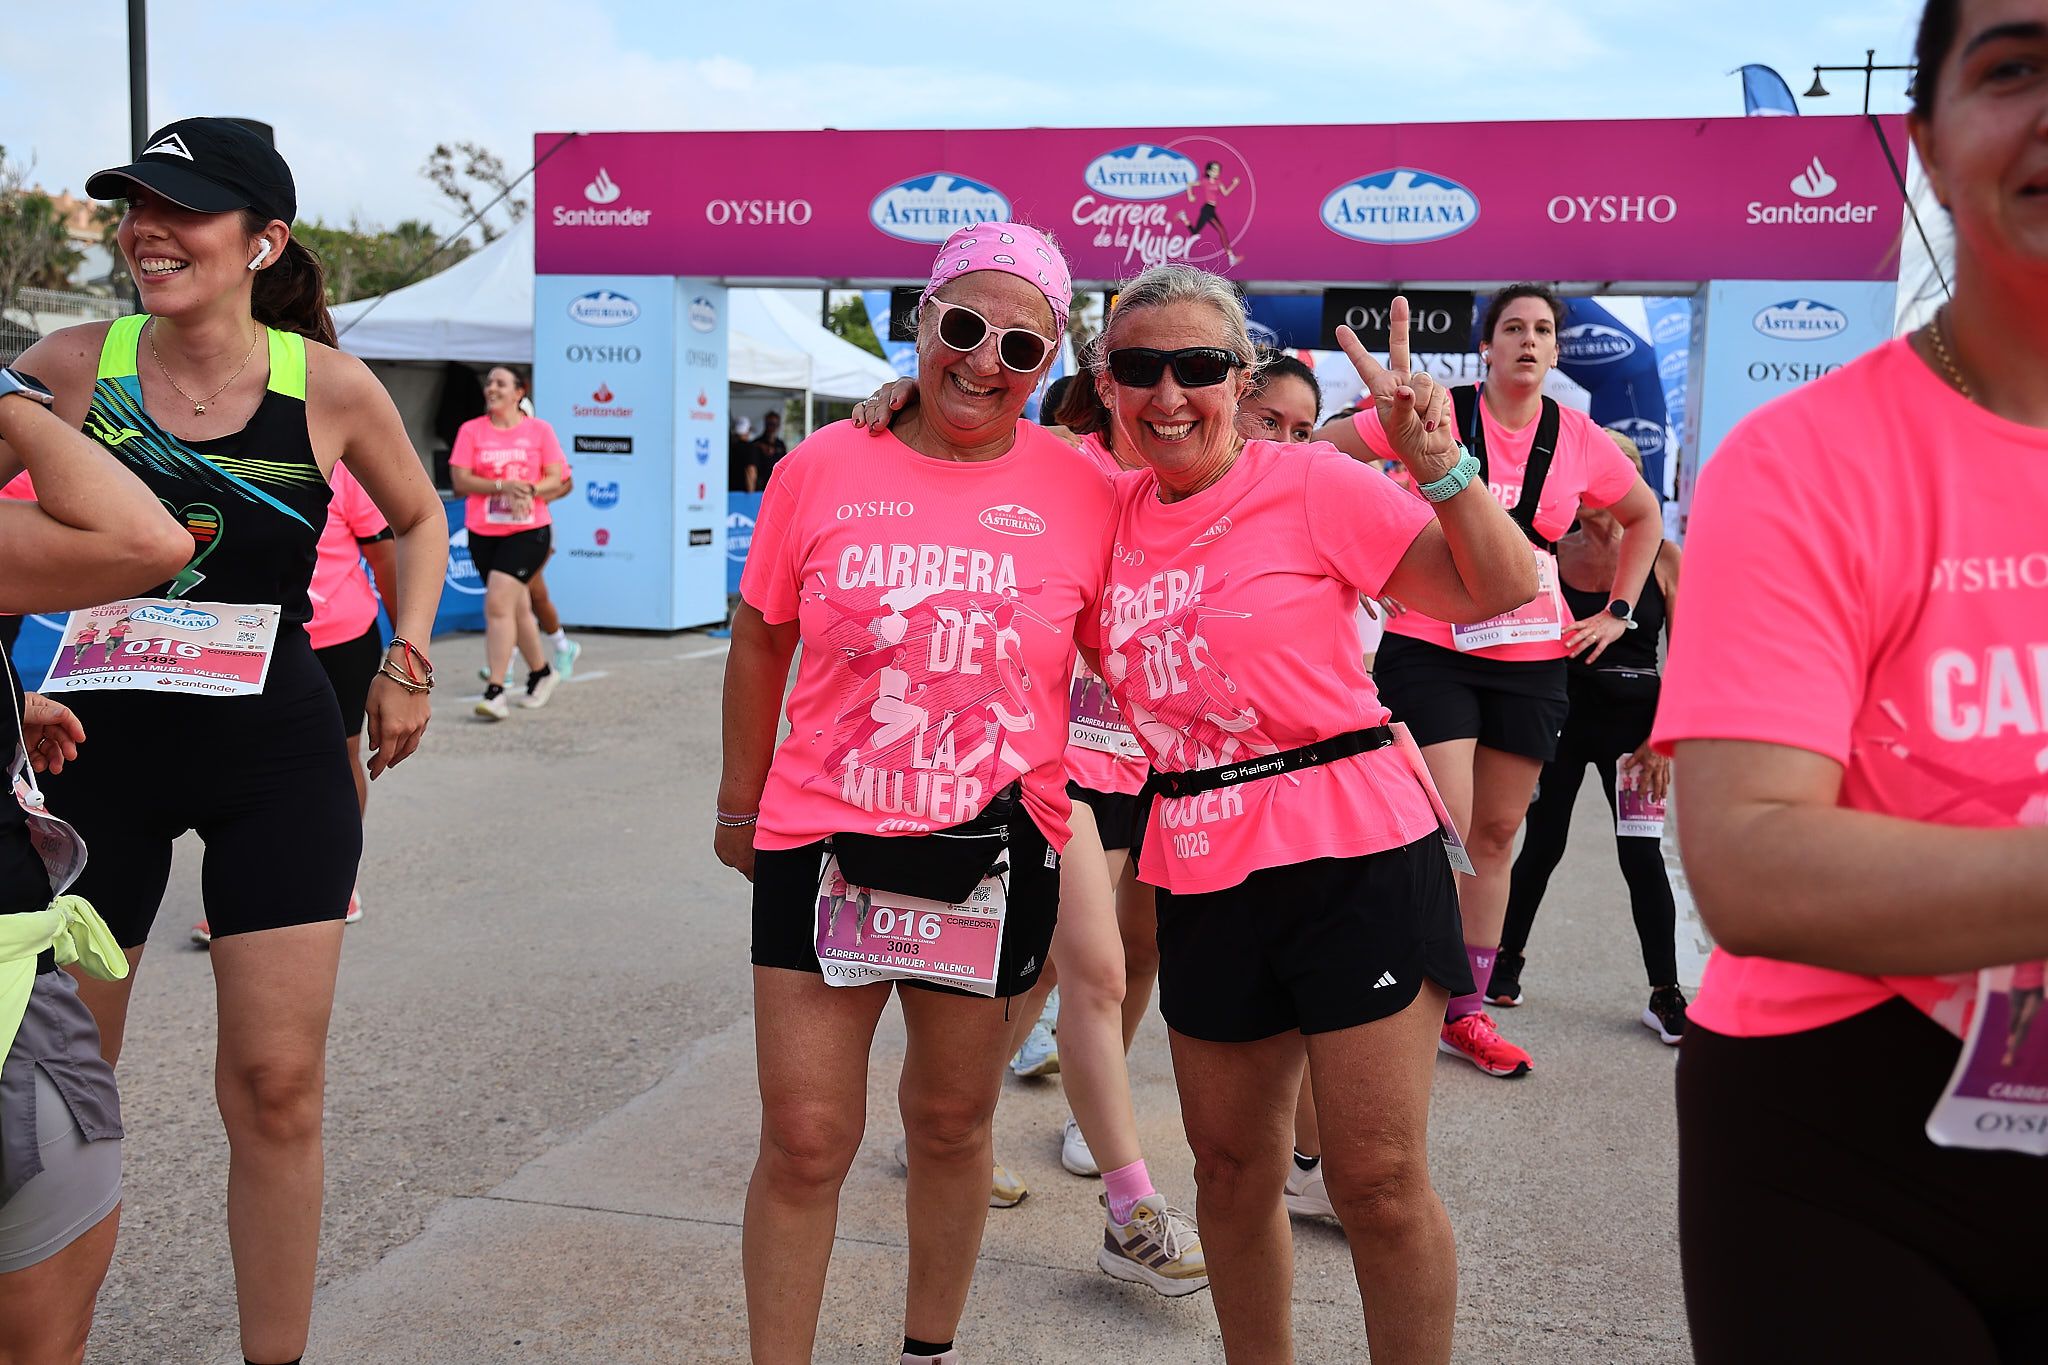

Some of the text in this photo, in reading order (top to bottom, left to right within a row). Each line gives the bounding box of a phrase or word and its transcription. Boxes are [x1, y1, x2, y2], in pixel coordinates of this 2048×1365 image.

[1094, 166, 1188, 186] ASTURIANA
[553, 206, 652, 227] Santander
[705, 199, 812, 226] OYSHO
[881, 200, 999, 225] ASTURIANA
[1072, 195, 1167, 228] Carrera
[1333, 198, 1466, 224] ASTURIANA
[1547, 195, 1677, 224] OYSHO
[1746, 202, 1878, 225] Santander
[1094, 223, 1201, 266] de la Mujer
[1345, 305, 1452, 335] OYHO
[1760, 315, 1841, 331] ASTURIANA
[566, 345, 642, 364] OYSHO
[572, 404, 634, 418] Santander
[576, 437, 631, 453] Neutrogena
[836, 501, 914, 520] OYSHO
[984, 512, 1041, 532] ASTURIANA
[1113, 542, 1145, 567] SHO
[836, 543, 1019, 597] CARRERA
[91, 607, 129, 618] SUMA
[136, 608, 212, 628] ASTURIANA
[926, 607, 995, 676] DE
[1465, 629, 1551, 645] OYSHO Santander
[124, 639, 202, 658] 016
[207, 649, 264, 658] CORREDORA
[140, 655, 178, 665] 3495
[1138, 625, 1190, 700] DE
[69, 665, 115, 677] CARRERA
[117, 664, 132, 672] DE
[149, 664, 184, 674] MUJER
[193, 668, 241, 681] VALENCIA
[66, 675, 238, 694] OYSHO Santander
[1076, 715, 1105, 729] CARRERA
[911, 709, 957, 771] LA
[1073, 729, 1111, 746] OYSHO
[1238, 758, 1286, 778] Kalenji
[839, 762, 983, 823] MUJER
[1173, 830, 1210, 860] 2026
[872, 907, 942, 940] 016
[946, 917, 997, 930] CORREDORA
[886, 940, 920, 955] 3003
[825, 947, 866, 962] CARRERA
[868, 953, 880, 964] DE
[881, 955, 893, 965] LA
[895, 957, 926, 970] MUJER
[933, 961, 976, 976] VALENCIA
[826, 964, 882, 979] OYSHO
